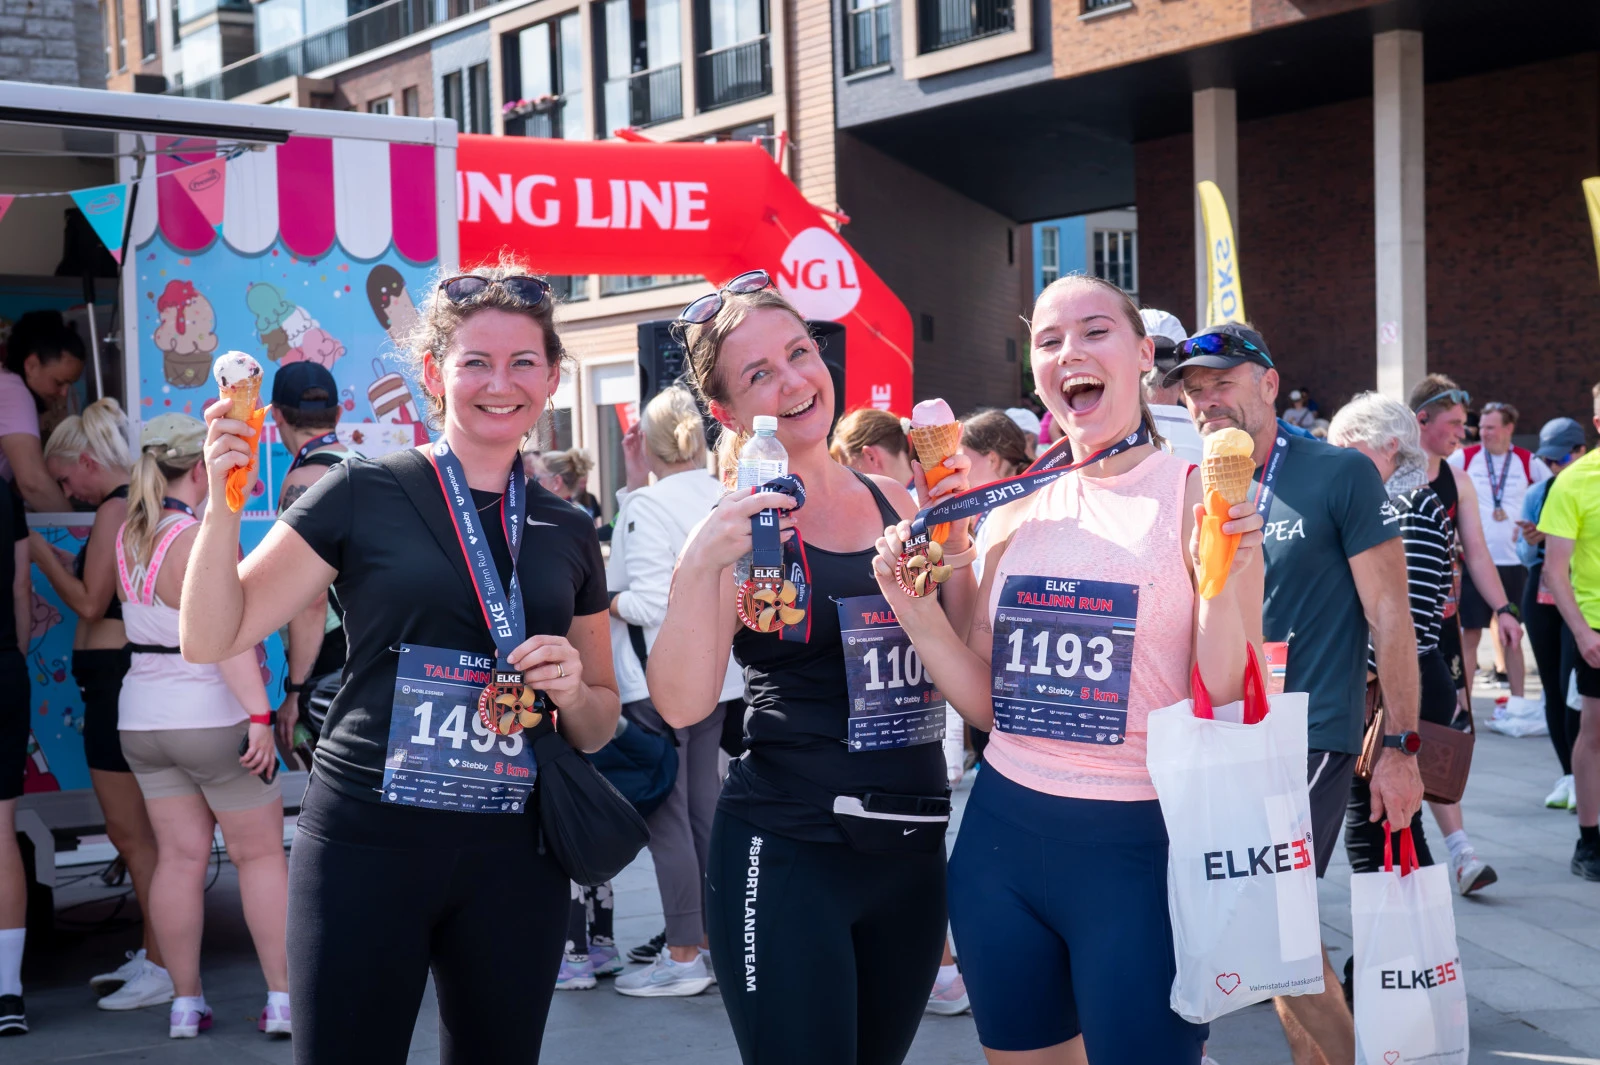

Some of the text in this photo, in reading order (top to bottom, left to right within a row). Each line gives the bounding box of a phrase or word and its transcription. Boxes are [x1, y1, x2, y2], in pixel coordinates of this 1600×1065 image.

[575, 177, 710, 231] LINE
[837, 259, 856, 289] L
[932, 483, 1025, 516] ELKE Tallinn Run
[463, 511, 475, 534] Stebby
[1263, 518, 1306, 545] PEA
[905, 535, 928, 548] ELKE
[754, 569, 781, 578] ELKE
[476, 550, 513, 638] ELKE Tallinn Run
[1045, 579, 1077, 593] ELKE
[1016, 591, 1113, 612] TALLINN RUN
[862, 610, 899, 625] TALL
[459, 654, 492, 670] ELKE
[1005, 628, 1114, 682] 1193
[423, 664, 491, 684] TALLINN
[496, 674, 522, 683] ELKE
[903, 695, 921, 705] Stebby
[923, 690, 929, 703] 5
[1048, 685, 1119, 703] Stebby 5 km
[410, 701, 523, 757] 1493
[461, 759, 529, 778] Stebby 5 km
[744, 835, 764, 992] #SPORTLANDTEAM
[1249, 975, 1324, 992] Valmistatud taaskasutat
[1381, 961, 1457, 989] ELKE35
